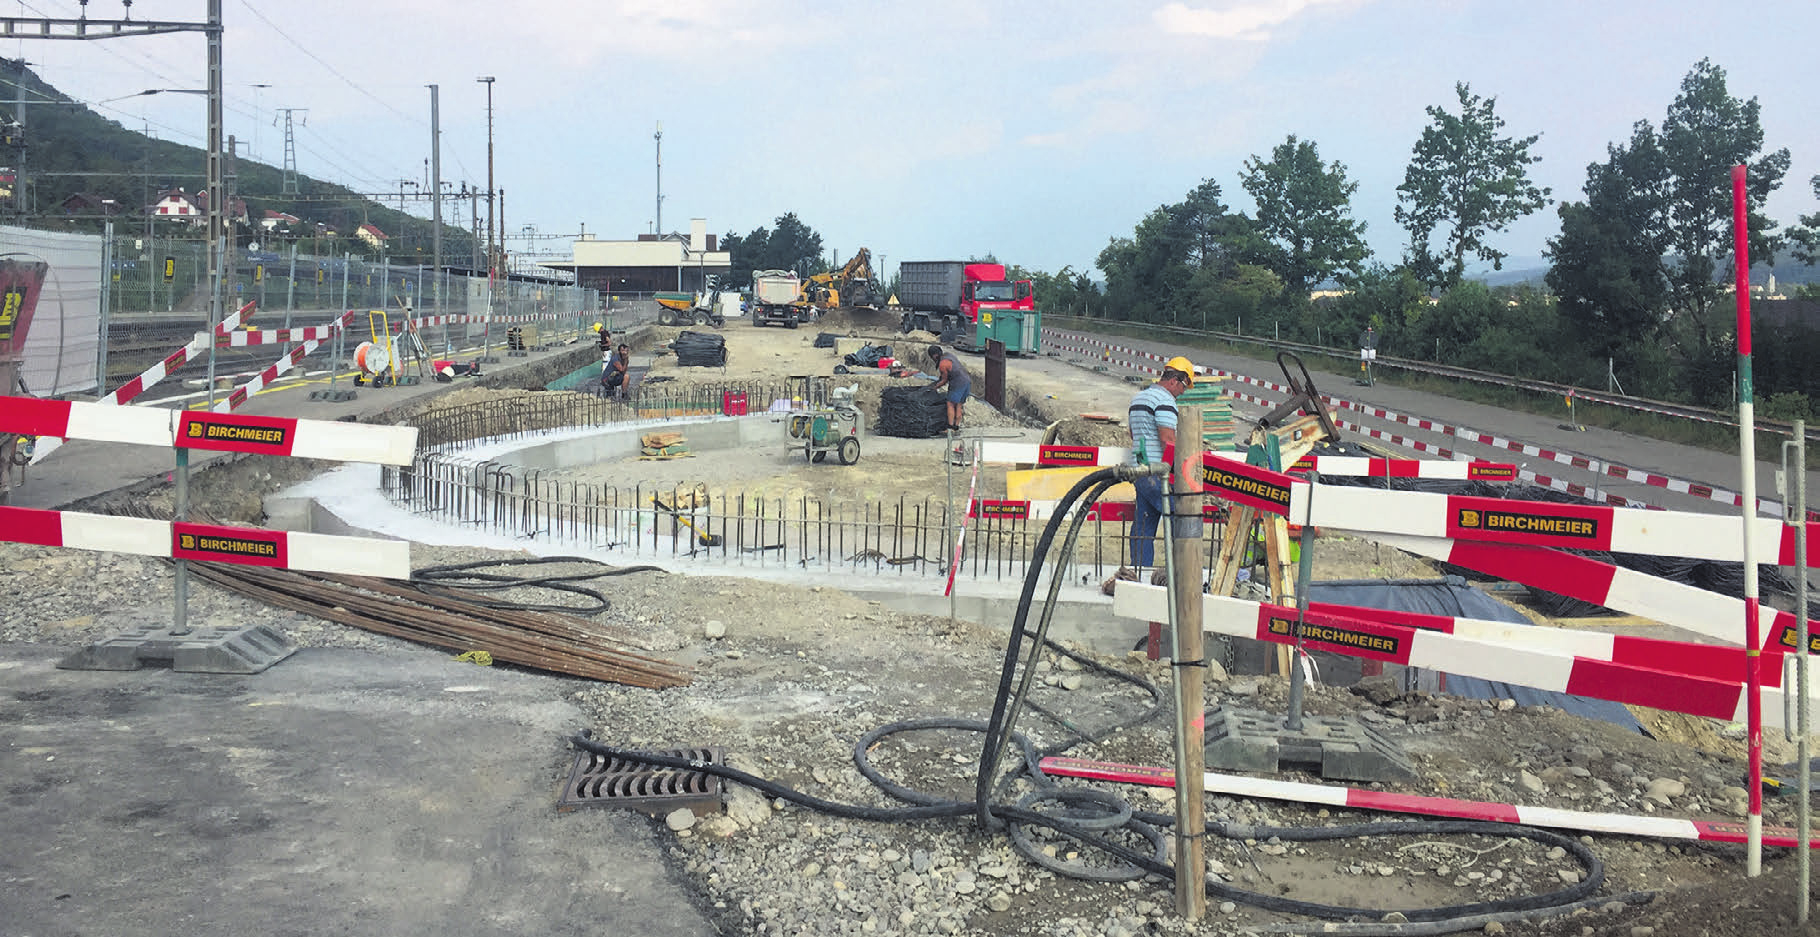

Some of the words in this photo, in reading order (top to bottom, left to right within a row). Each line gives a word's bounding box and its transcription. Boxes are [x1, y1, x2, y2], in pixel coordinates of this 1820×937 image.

[208, 426, 281, 441] BIRCHMEIER
[1480, 468, 1512, 476] BIRCHMEIER
[1488, 515, 1593, 535] BIRCHMEIER
[200, 538, 273, 554] BIRCHMEIER
[1297, 624, 1394, 651] BIRCHMEIER
